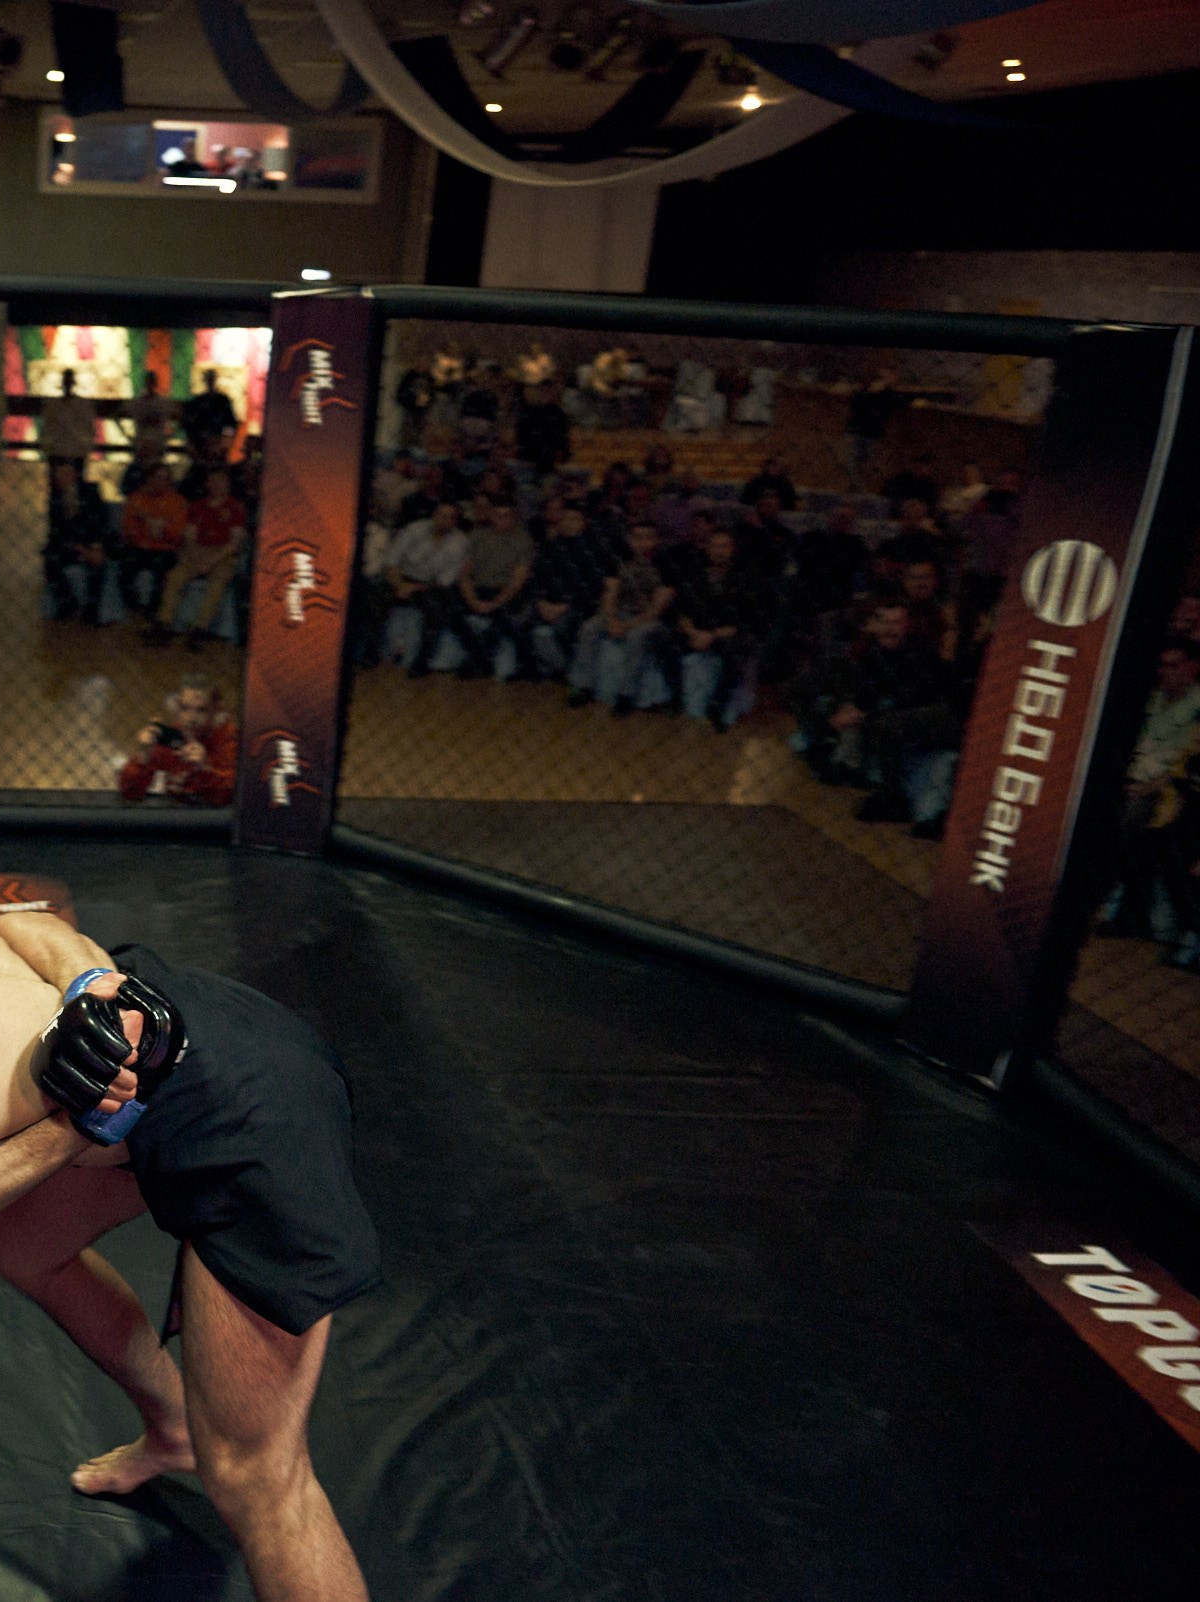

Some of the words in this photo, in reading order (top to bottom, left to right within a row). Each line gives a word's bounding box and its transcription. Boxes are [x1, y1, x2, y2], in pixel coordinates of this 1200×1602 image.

[308, 349, 334, 389] MIX
[1002, 639, 1077, 762] НБД
[969, 766, 1045, 892] Банк
[1030, 1244, 1200, 1413] TOPG
